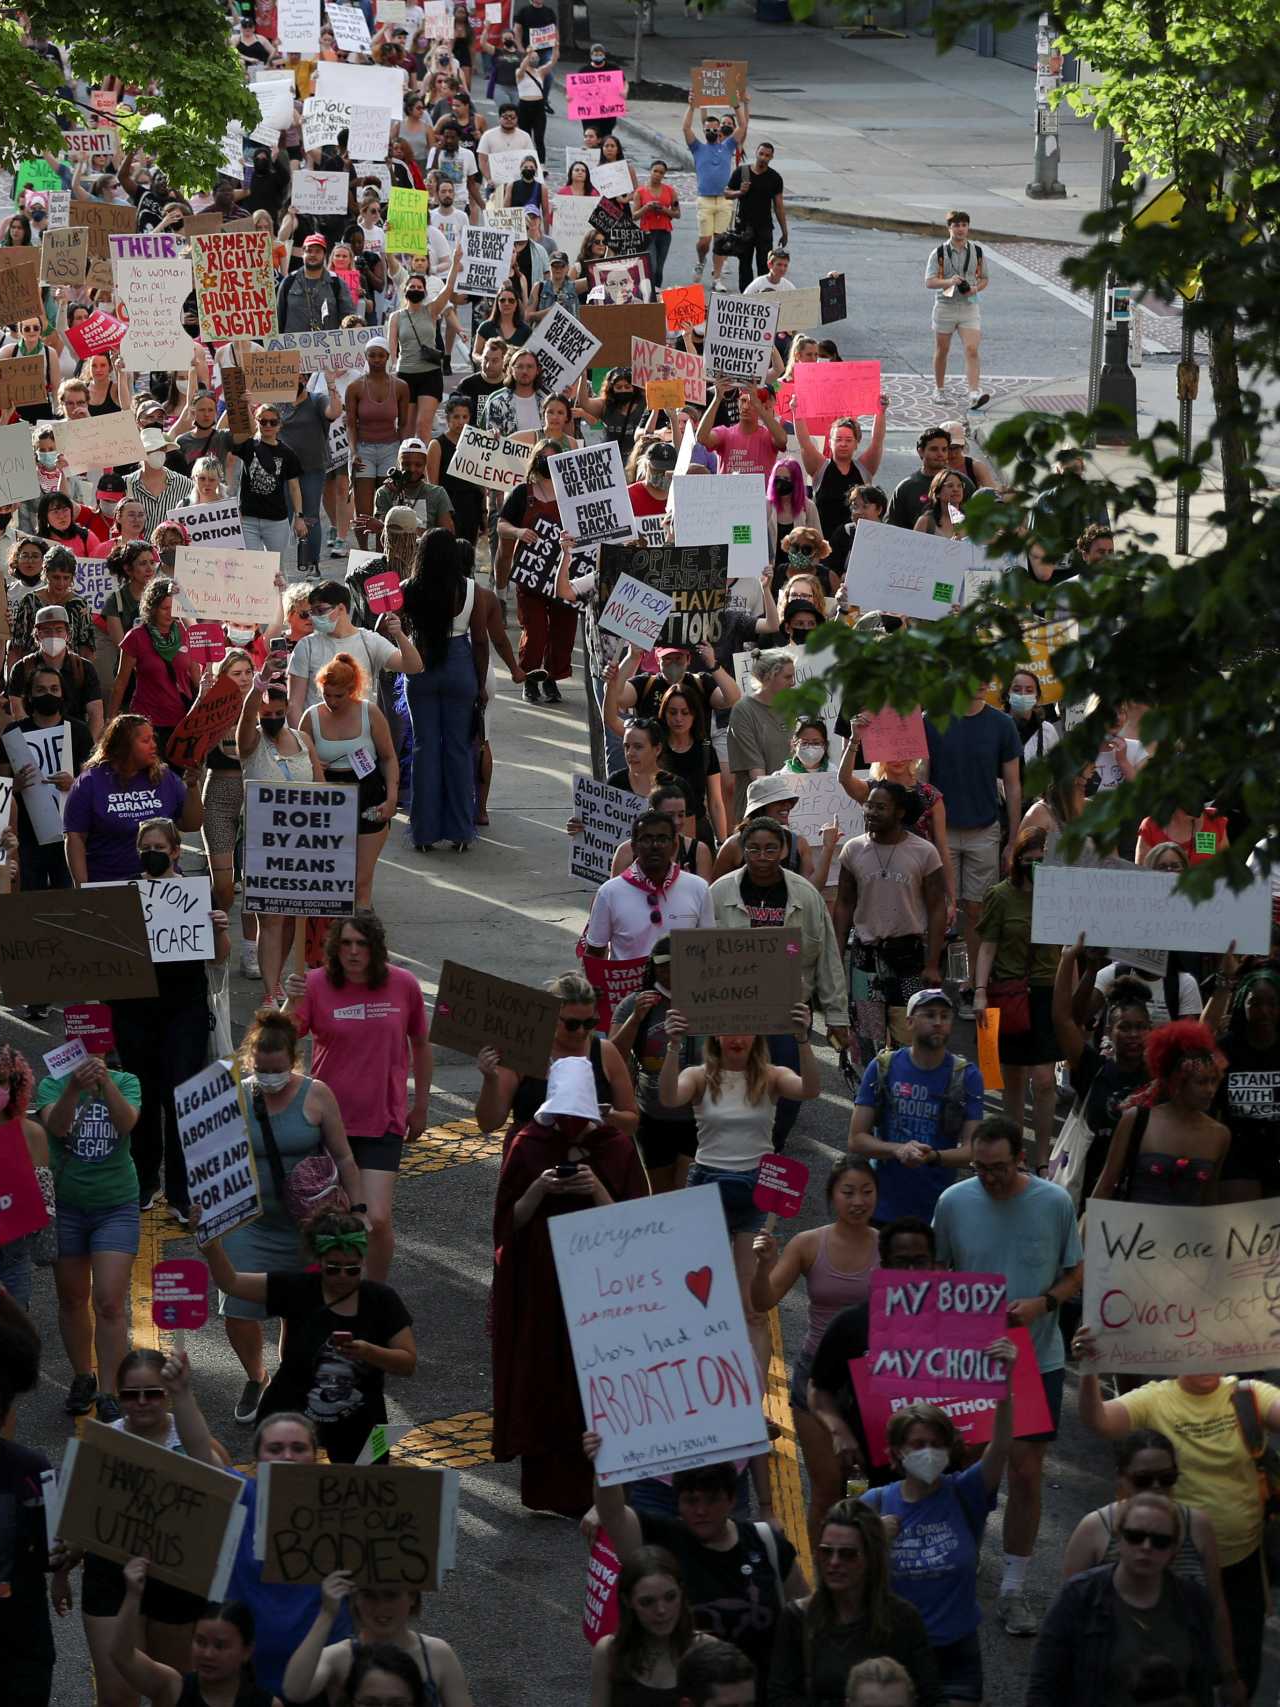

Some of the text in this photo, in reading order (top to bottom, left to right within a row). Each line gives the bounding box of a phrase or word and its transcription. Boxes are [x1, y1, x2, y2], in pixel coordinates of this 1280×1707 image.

[110, 235, 176, 258] THEIR
[467, 230, 509, 243] WE WON'T
[468, 240, 504, 252] GO BACK
[207, 249, 264, 274] RIGHTS
[467, 249, 503, 261] WE WILL
[470, 264, 497, 276] FIGHT
[221, 271, 253, 292] ARE
[467, 275, 496, 288] BACK!
[201, 288, 268, 315] HUMAN
[717, 300, 770, 318] WORKERS
[212, 311, 274, 337] RIGHTS
[553, 310, 595, 348] WE WON'T
[717, 313, 766, 330] UNITE TO
[268, 327, 385, 350] ABORTION
[549, 321, 587, 356] GO BACK
[719, 325, 761, 342] DEFEND
[543, 332, 577, 366] WE WILL
[633, 341, 704, 377] MY BODY
[710, 344, 764, 362] WOMEN'S
[537, 349, 565, 376] FIGHT
[713, 357, 757, 374] RIGHTS!
[480, 452, 490, 462] IS
[555, 448, 612, 473] WE WON'T
[562, 462, 612, 484] GO BACK
[564, 476, 616, 497] WE WILL
[576, 499, 612, 521] FIGHT
[534, 518, 561, 540] IT'S
[578, 514, 619, 536] BACK!
[520, 550, 546, 571] IT'S
[76, 576, 113, 592] SAFE
[512, 566, 539, 588] IT'S
[620, 581, 640, 601] MY
[604, 601, 624, 622] MY
[107, 789, 157, 805] STACEY
[258, 787, 346, 806] DEFEND
[575, 792, 601, 814] Sup.
[577, 777, 642, 811] Abolish the
[107, 799, 163, 814] ABRAMS
[273, 810, 330, 829] ROE!
[582, 811, 623, 839] Enemy
[262, 832, 343, 850] BY ANY
[265, 857, 335, 873] MEANS
[573, 845, 604, 869] Fight
[246, 875, 355, 892] NECESSARY!
[715, 937, 779, 956] RIGHTS
[607, 977, 643, 990] WITH
[1231, 1090, 1272, 1103] WITH
[182, 1099, 240, 1149] ABORTION
[187, 1139, 250, 1189] ONCE AND
[223, 1166, 253, 1199] ALL!
[1102, 1220, 1215, 1262] We are
[884, 1280, 1008, 1316] MY BODY
[646, 1318, 734, 1352] had an
[873, 1349, 921, 1381] MY
[586, 1348, 754, 1437] ABORTION
[161, 1482, 209, 1516] OFF
[319, 1477, 399, 1506] BANS
[290, 1506, 417, 1531] OFF OUR
[273, 1529, 430, 1586] BODIES
